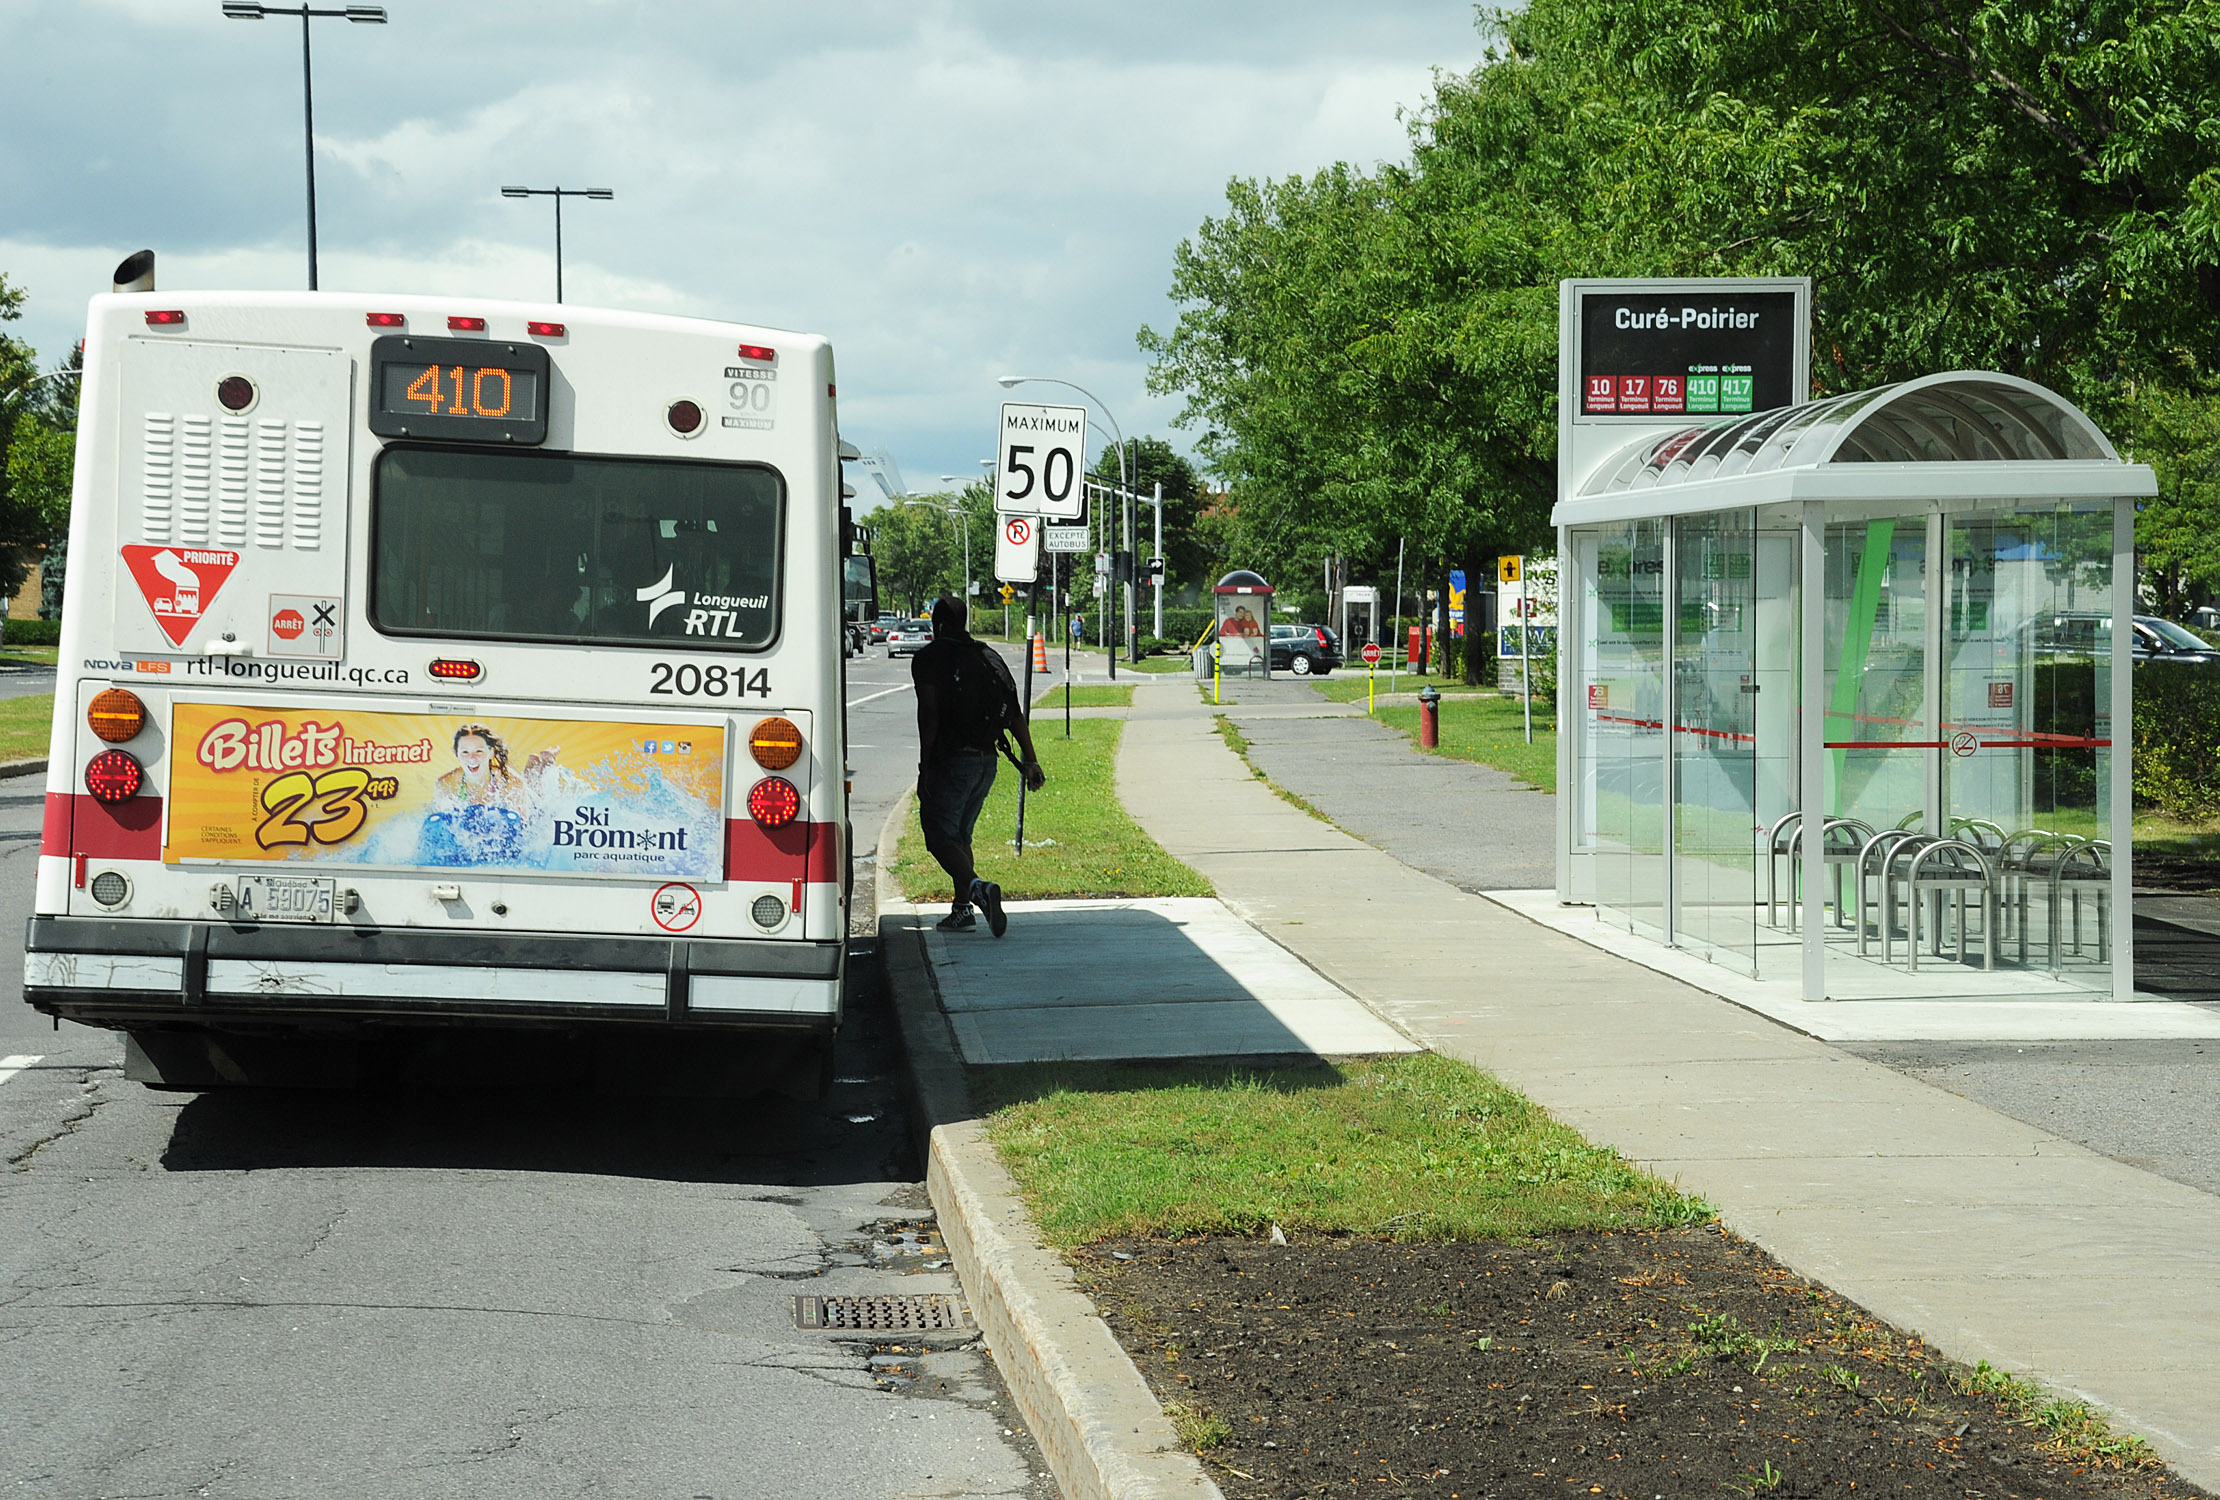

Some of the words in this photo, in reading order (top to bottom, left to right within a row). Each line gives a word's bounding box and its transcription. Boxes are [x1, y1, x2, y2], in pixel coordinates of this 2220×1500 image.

[1615, 307, 1759, 330] Curé-Poirier
[727, 368, 774, 380] VITESSE
[406, 364, 511, 417] 410
[1591, 379, 1610, 395] 10
[1625, 379, 1645, 395] 17
[1658, 379, 1677, 395] 76
[1688, 379, 1716, 395] 410
[1722, 379, 1750, 395] 417
[730, 382, 770, 411] 90
[724, 418, 772, 429] MAXIMUM
[1007, 416, 1079, 434] MAXIMUM
[1006, 445, 1074, 502] 50
[1049, 530, 1086, 540] EXCEPTÉ
[1049, 540, 1087, 548] AUTOBUS
[183, 550, 235, 567] PRIORITÉ
[1598, 553, 1664, 580] expres
[692, 591, 769, 610] Longueuil
[273, 616, 303, 632] ARRÊT
[684, 609, 744, 638] RTL
[1363, 649, 1380, 657] ARRÊT
[138, 662, 168, 672] LFS
[187, 656, 409, 687] rtl-longueuil.qc.ca
[650, 663, 772, 698] 20814
[1592, 686, 1604, 697] 76
[198, 719, 343, 772] Billets
[344, 739, 432, 765] Internet
[253, 777, 259, 786] DE
[255, 766, 371, 851] 23
[575, 806, 609, 826] Ski
[573, 851, 600, 862] parc
[603, 852, 665, 863] aquatique
[276, 880, 308, 888] Québec
[240, 887, 253, 911] A
[266, 888, 330, 913] 59075
